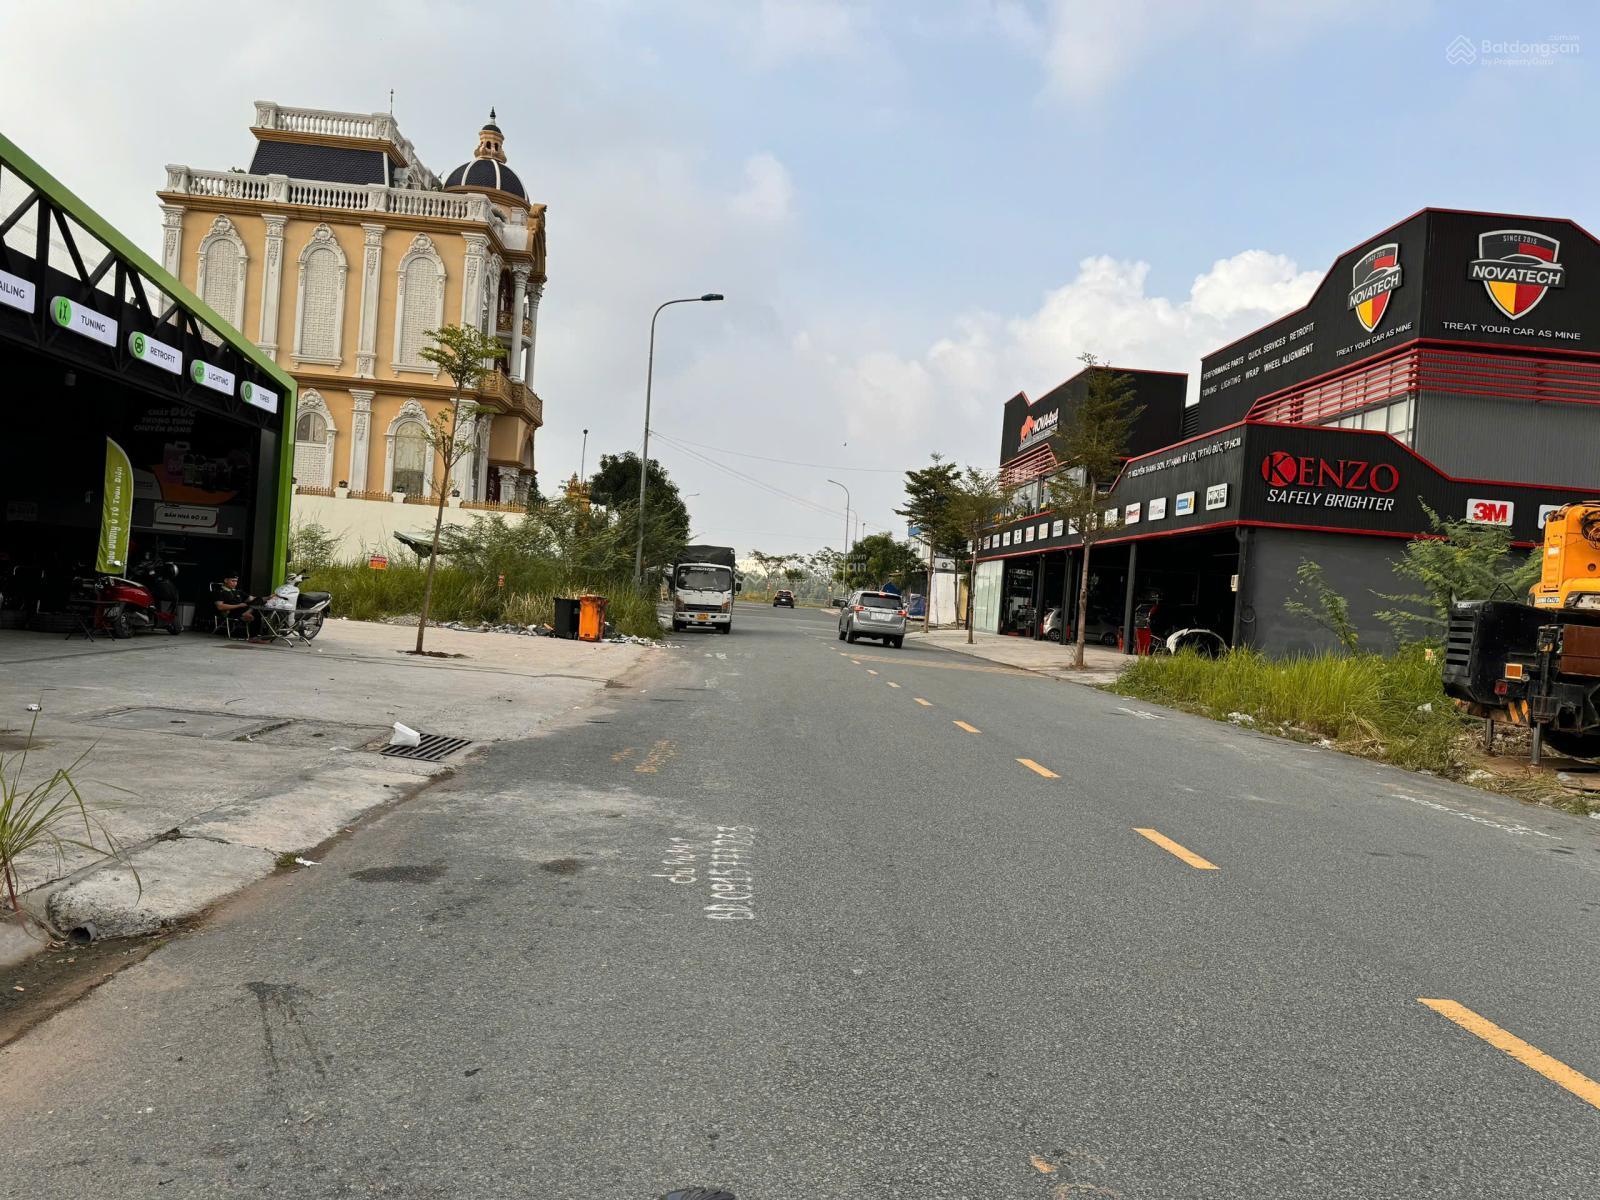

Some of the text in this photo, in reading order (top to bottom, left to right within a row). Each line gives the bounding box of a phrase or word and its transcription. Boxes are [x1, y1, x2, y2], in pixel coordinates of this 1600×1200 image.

[1503, 235, 1522, 243] SINCE
[1472, 265, 1561, 285] NOVATECH
[1349, 272, 1399, 307] NOVATECH
[80, 314, 106, 333] TUNING
[1442, 321, 1581, 340] TREAT YOUR CAR AS MINE
[1336, 321, 1412, 357] TREAT YOUR CAR AS MINE
[150, 346, 176, 364] RETROFIT
[1203, 322, 1315, 380] PERFORMANCE PARTS QUICK SERVICES RETROFIT
[1220, 374, 1241, 390] LIGHTING
[1245, 366, 1260, 379] WRAP
[1263, 358, 1281, 372] WHEEL
[1281, 343, 1314, 365] ALIGNMENT
[208, 369, 229, 386] LIGHTING
[1261, 451, 1400, 493] KENZO
[1267, 489, 1395, 511] SAFELY BRIGHTER
[1473, 502, 1508, 523] 3M
